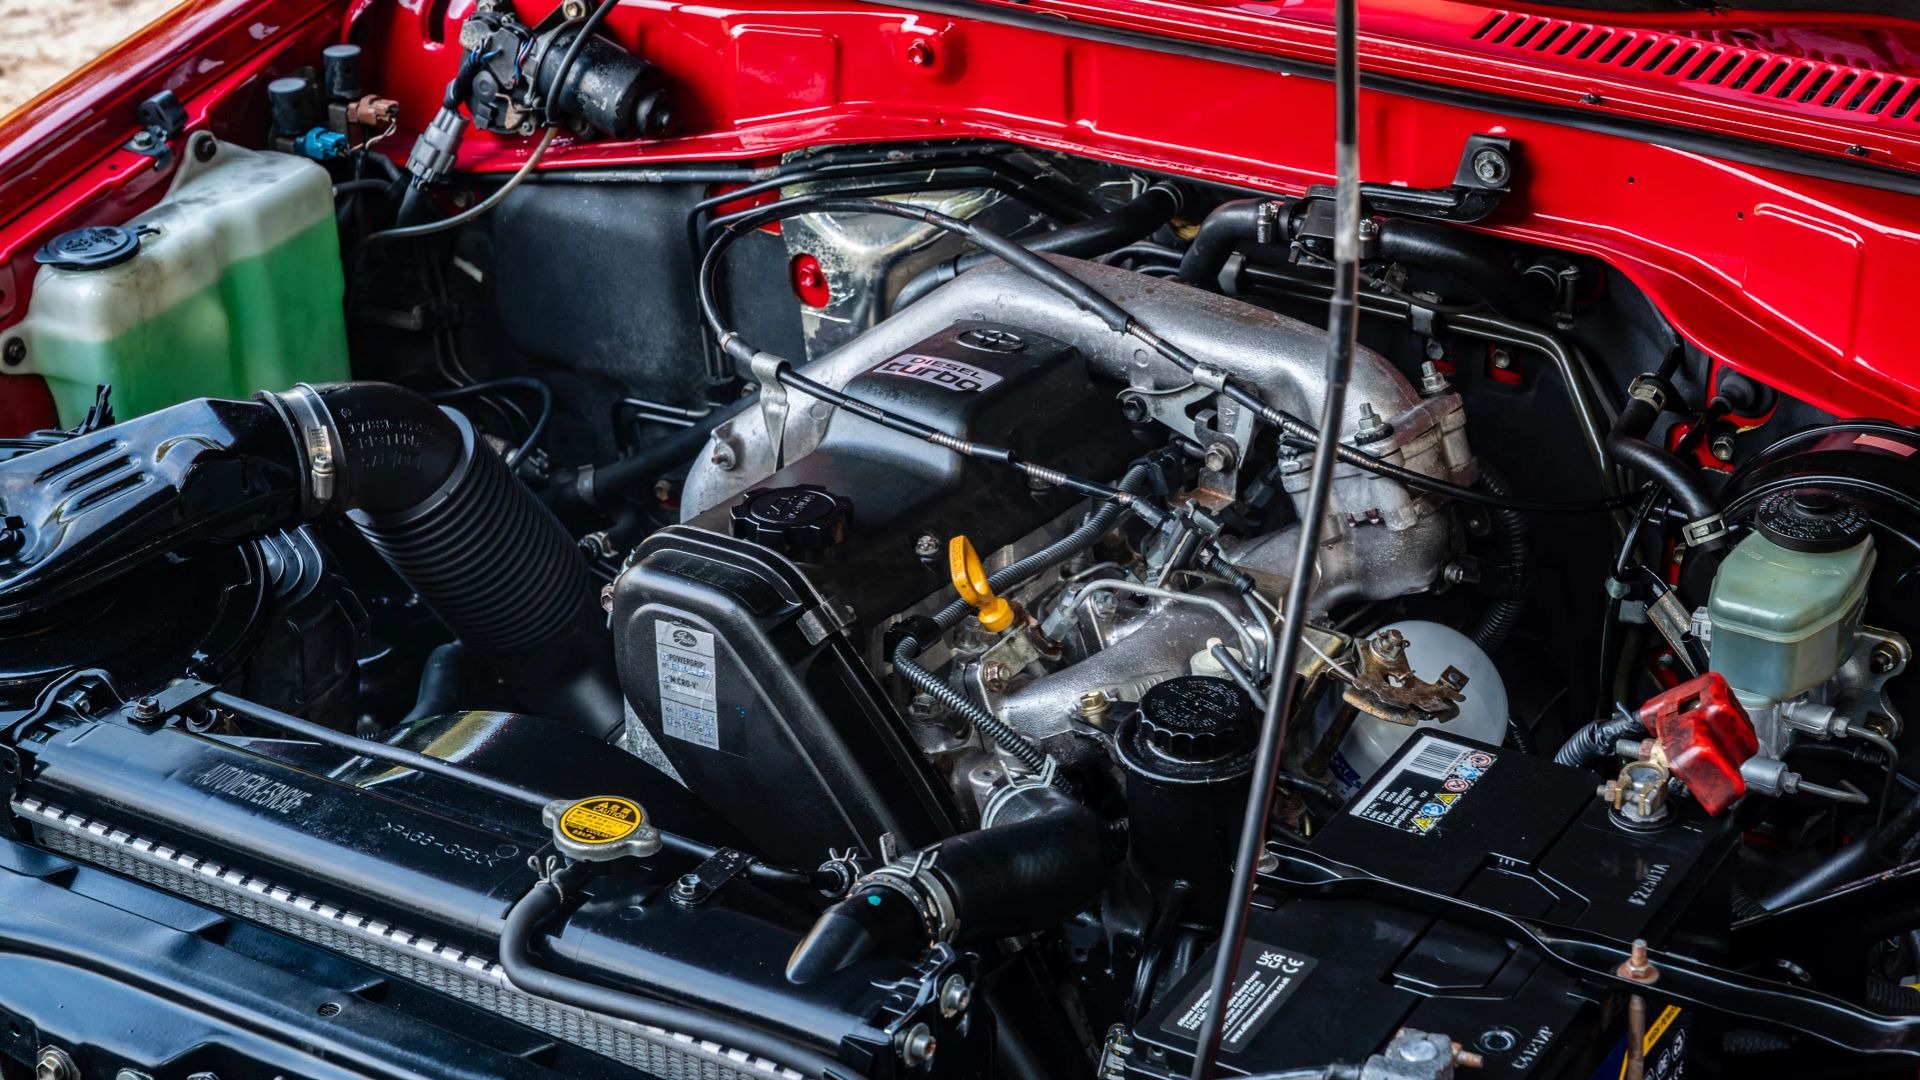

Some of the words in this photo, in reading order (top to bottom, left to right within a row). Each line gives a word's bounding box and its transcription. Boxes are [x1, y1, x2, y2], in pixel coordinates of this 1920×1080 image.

[909, 357, 983, 380] DIESEL
[593, 806, 628, 819] CAUTION
[1256, 950, 1276, 966] UK
[1268, 954, 1287, 969] CA
